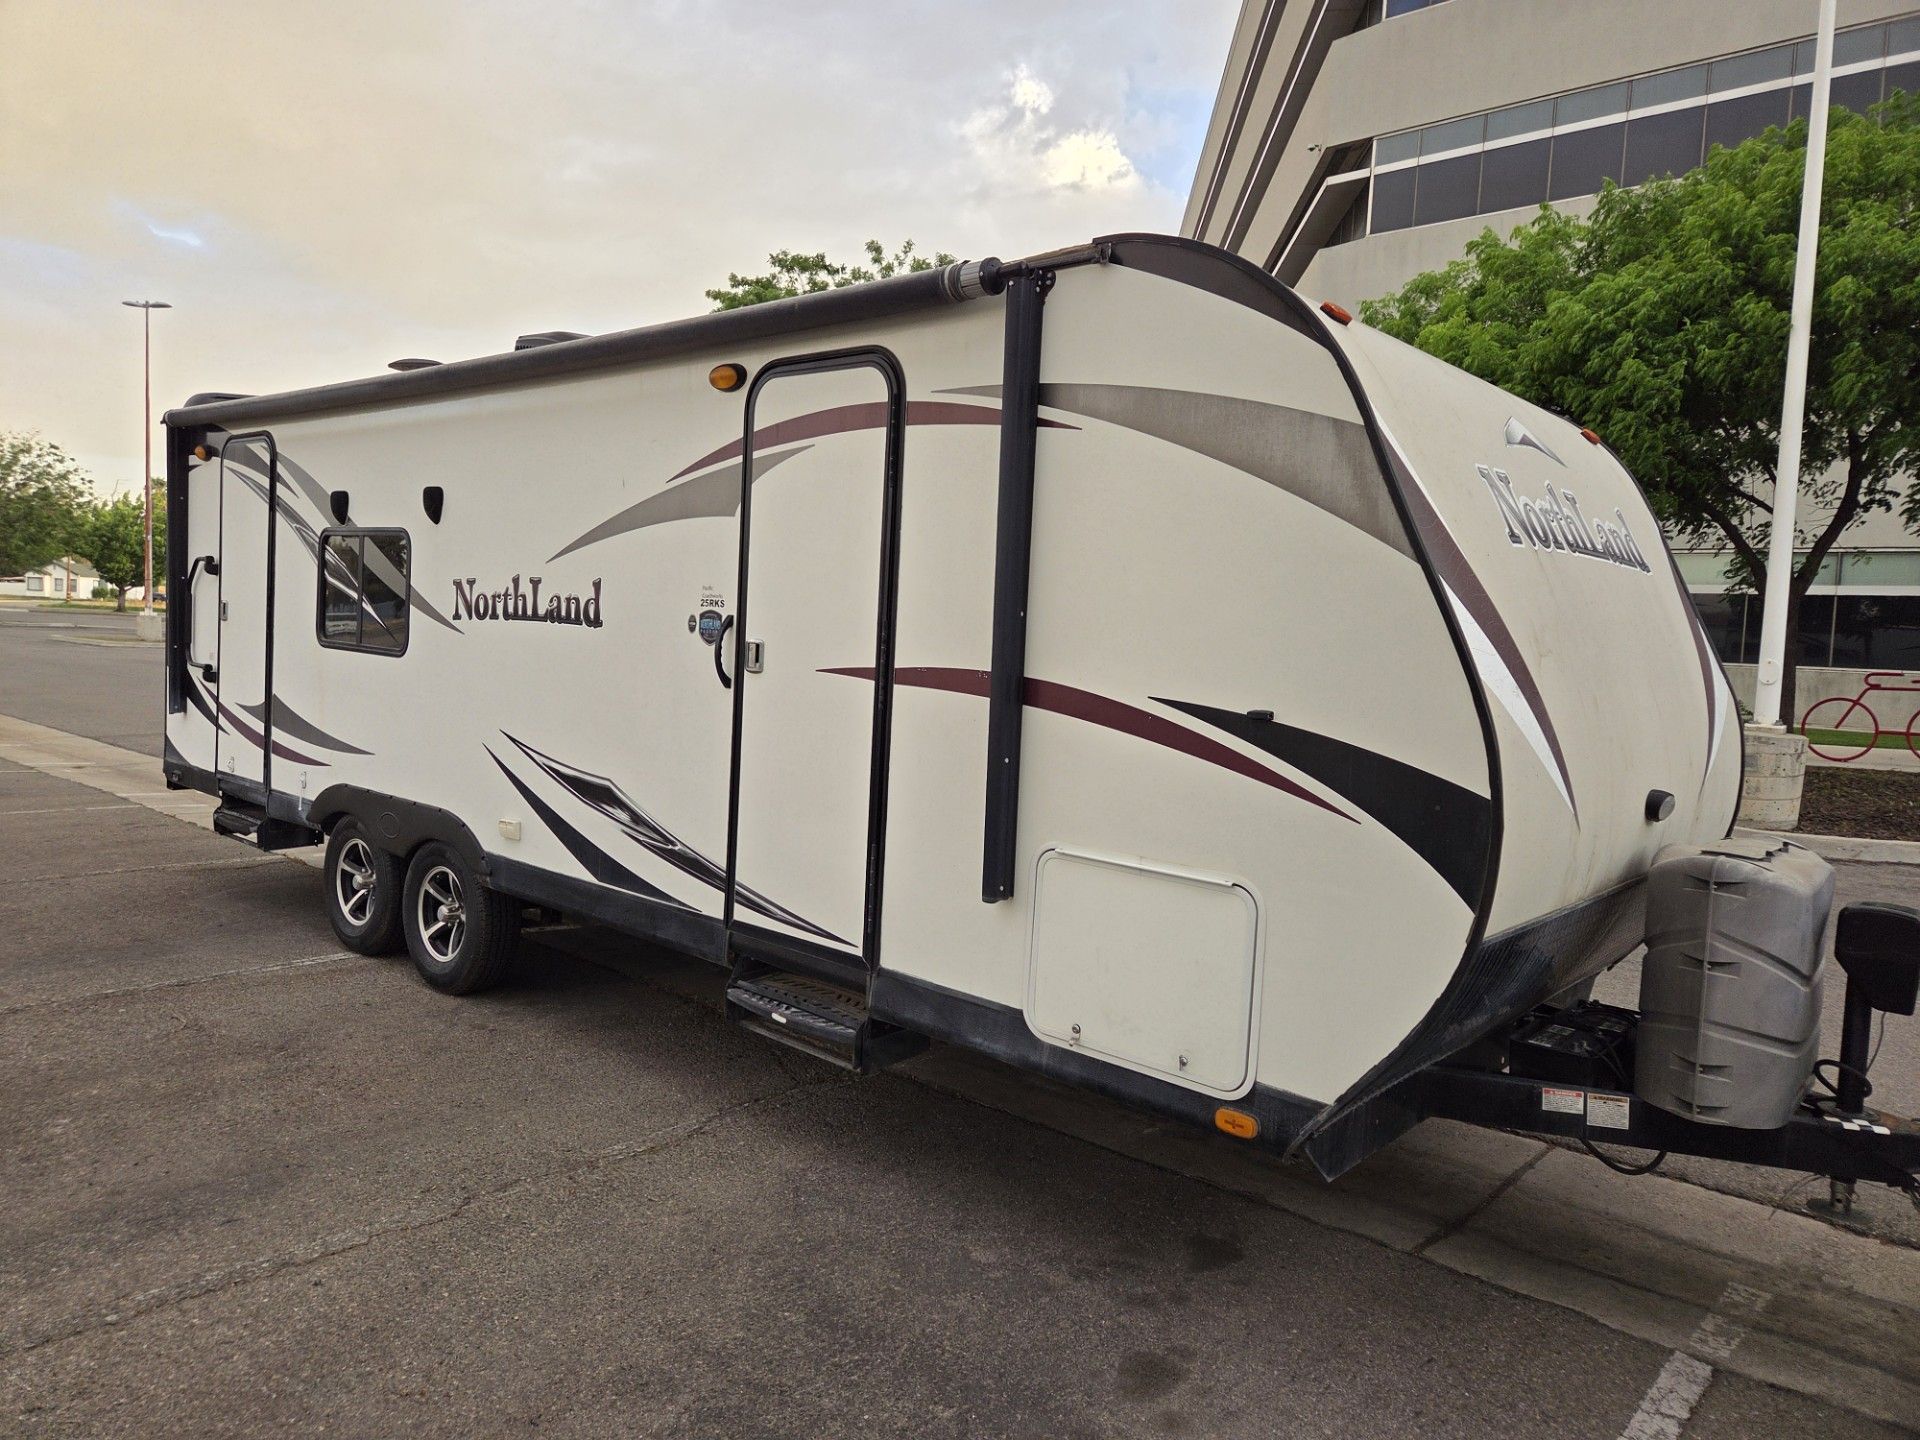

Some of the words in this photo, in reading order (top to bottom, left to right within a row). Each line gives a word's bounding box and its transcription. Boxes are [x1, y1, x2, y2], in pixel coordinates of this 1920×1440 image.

[1475, 463, 1653, 575] NorthLand
[452, 574, 603, 628] NorthLand
[700, 598, 725, 608] 25RKS
